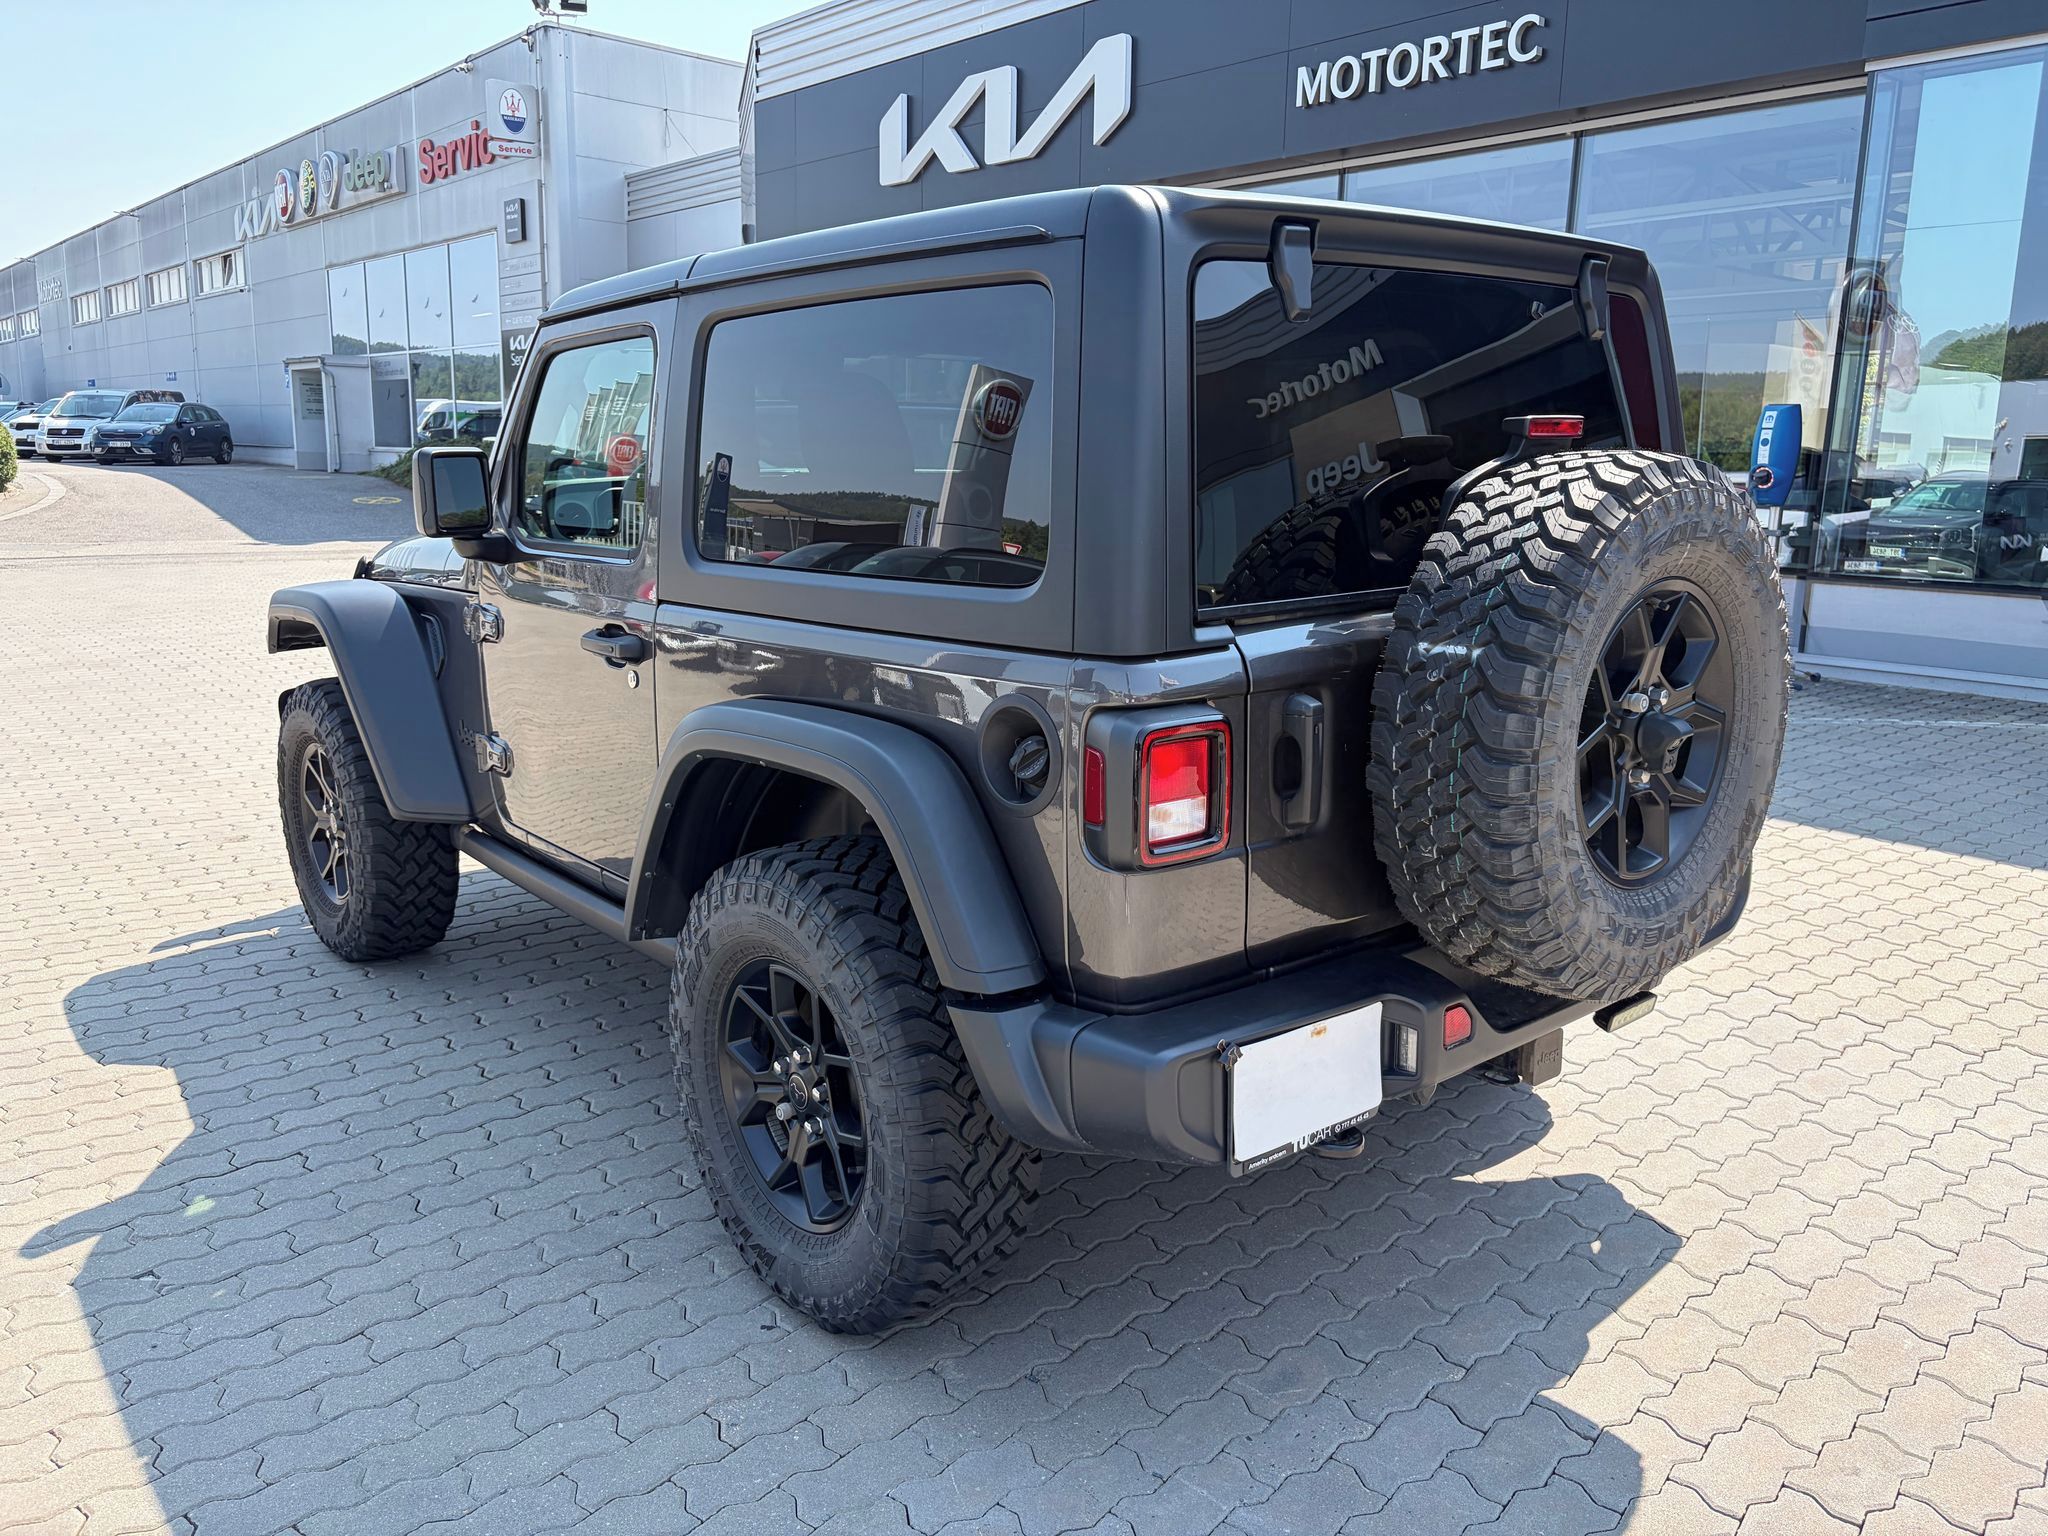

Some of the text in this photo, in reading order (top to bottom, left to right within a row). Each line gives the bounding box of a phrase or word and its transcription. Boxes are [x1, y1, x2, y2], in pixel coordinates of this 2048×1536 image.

[1295, 14, 1546, 110] MOTORTEC
[878, 33, 1134, 187] KIA
[344, 149, 390, 193] Jeep
[419, 119, 514, 184] Servic
[498, 144, 533, 155] Service
